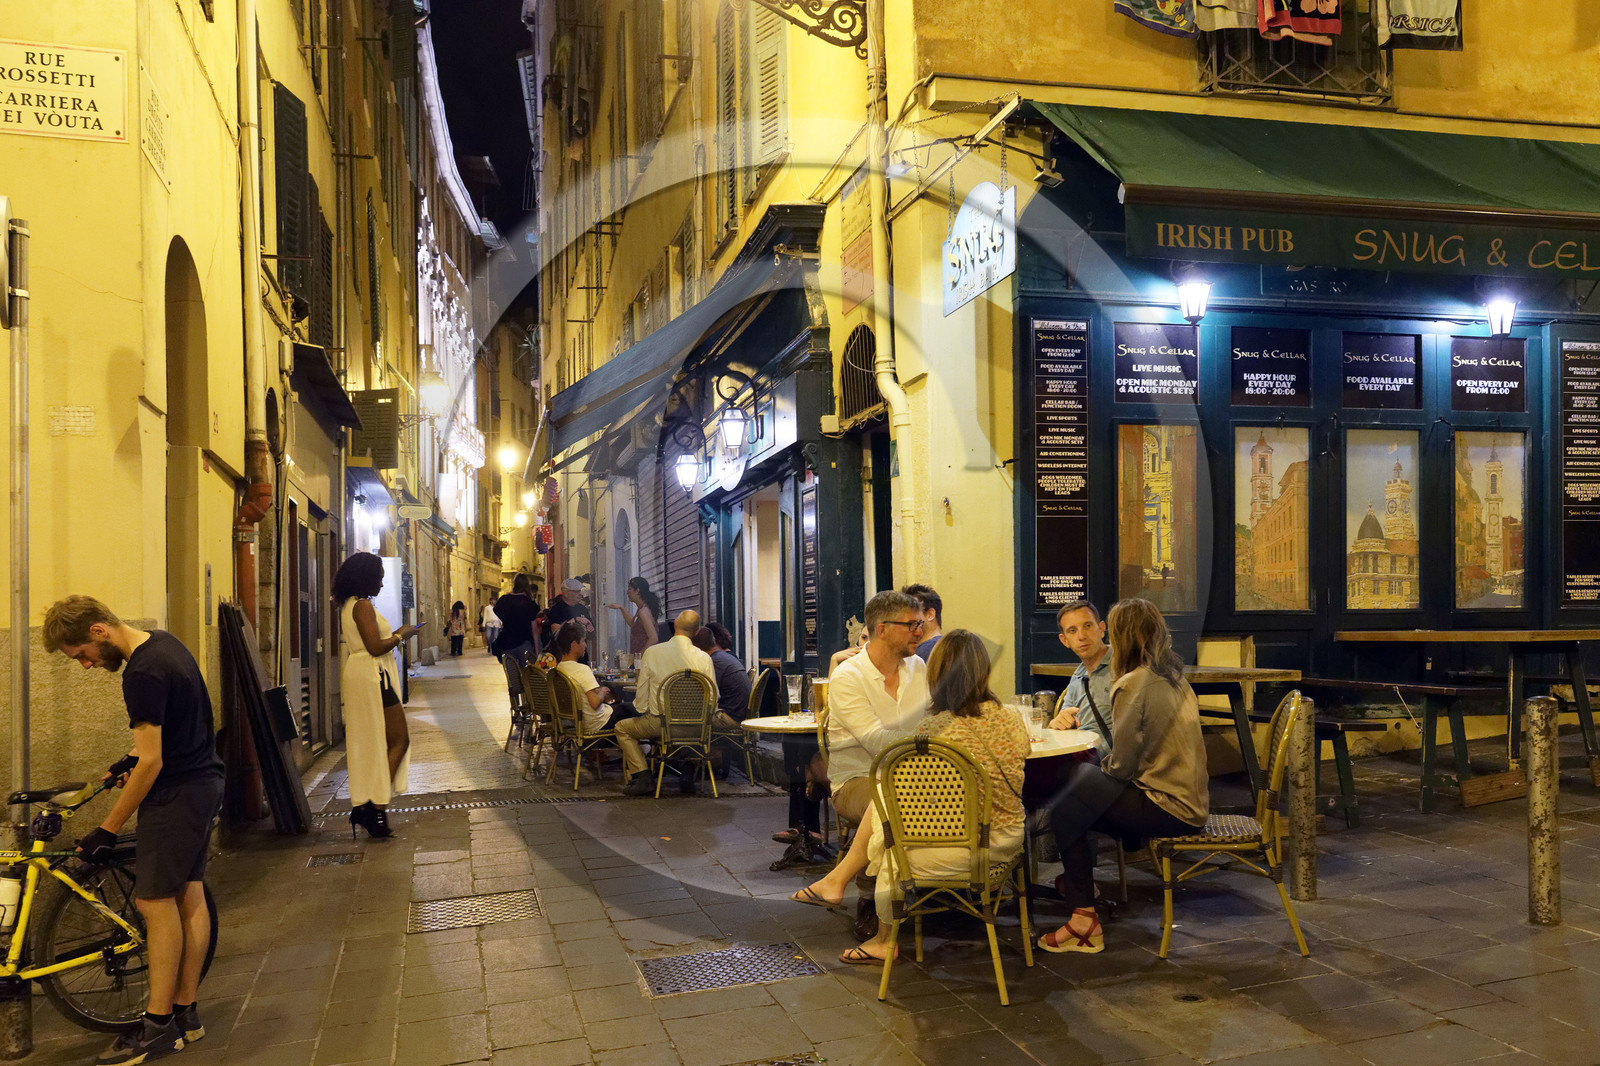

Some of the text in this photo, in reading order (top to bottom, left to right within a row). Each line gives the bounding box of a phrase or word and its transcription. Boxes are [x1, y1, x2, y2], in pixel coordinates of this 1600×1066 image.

[25, 52, 65, 67] RUE
[0, 90, 100, 112] ARRIERA
[0, 110, 104, 130] EI VÒUTA
[1155, 222, 1294, 253] IRISH PUB
[1352, 228, 1600, 271] SNUG & CEL
[1149, 345, 1157, 354] &
[1262, 349, 1270, 358] &
[1373, 354, 1380, 362] &
[1481, 357, 1488, 365] &
[1132, 364, 1182, 373] LIVE MUSIC
[1159, 380, 1198, 388] MONDAY
[1370, 376, 1414, 385] AVAILABLE
